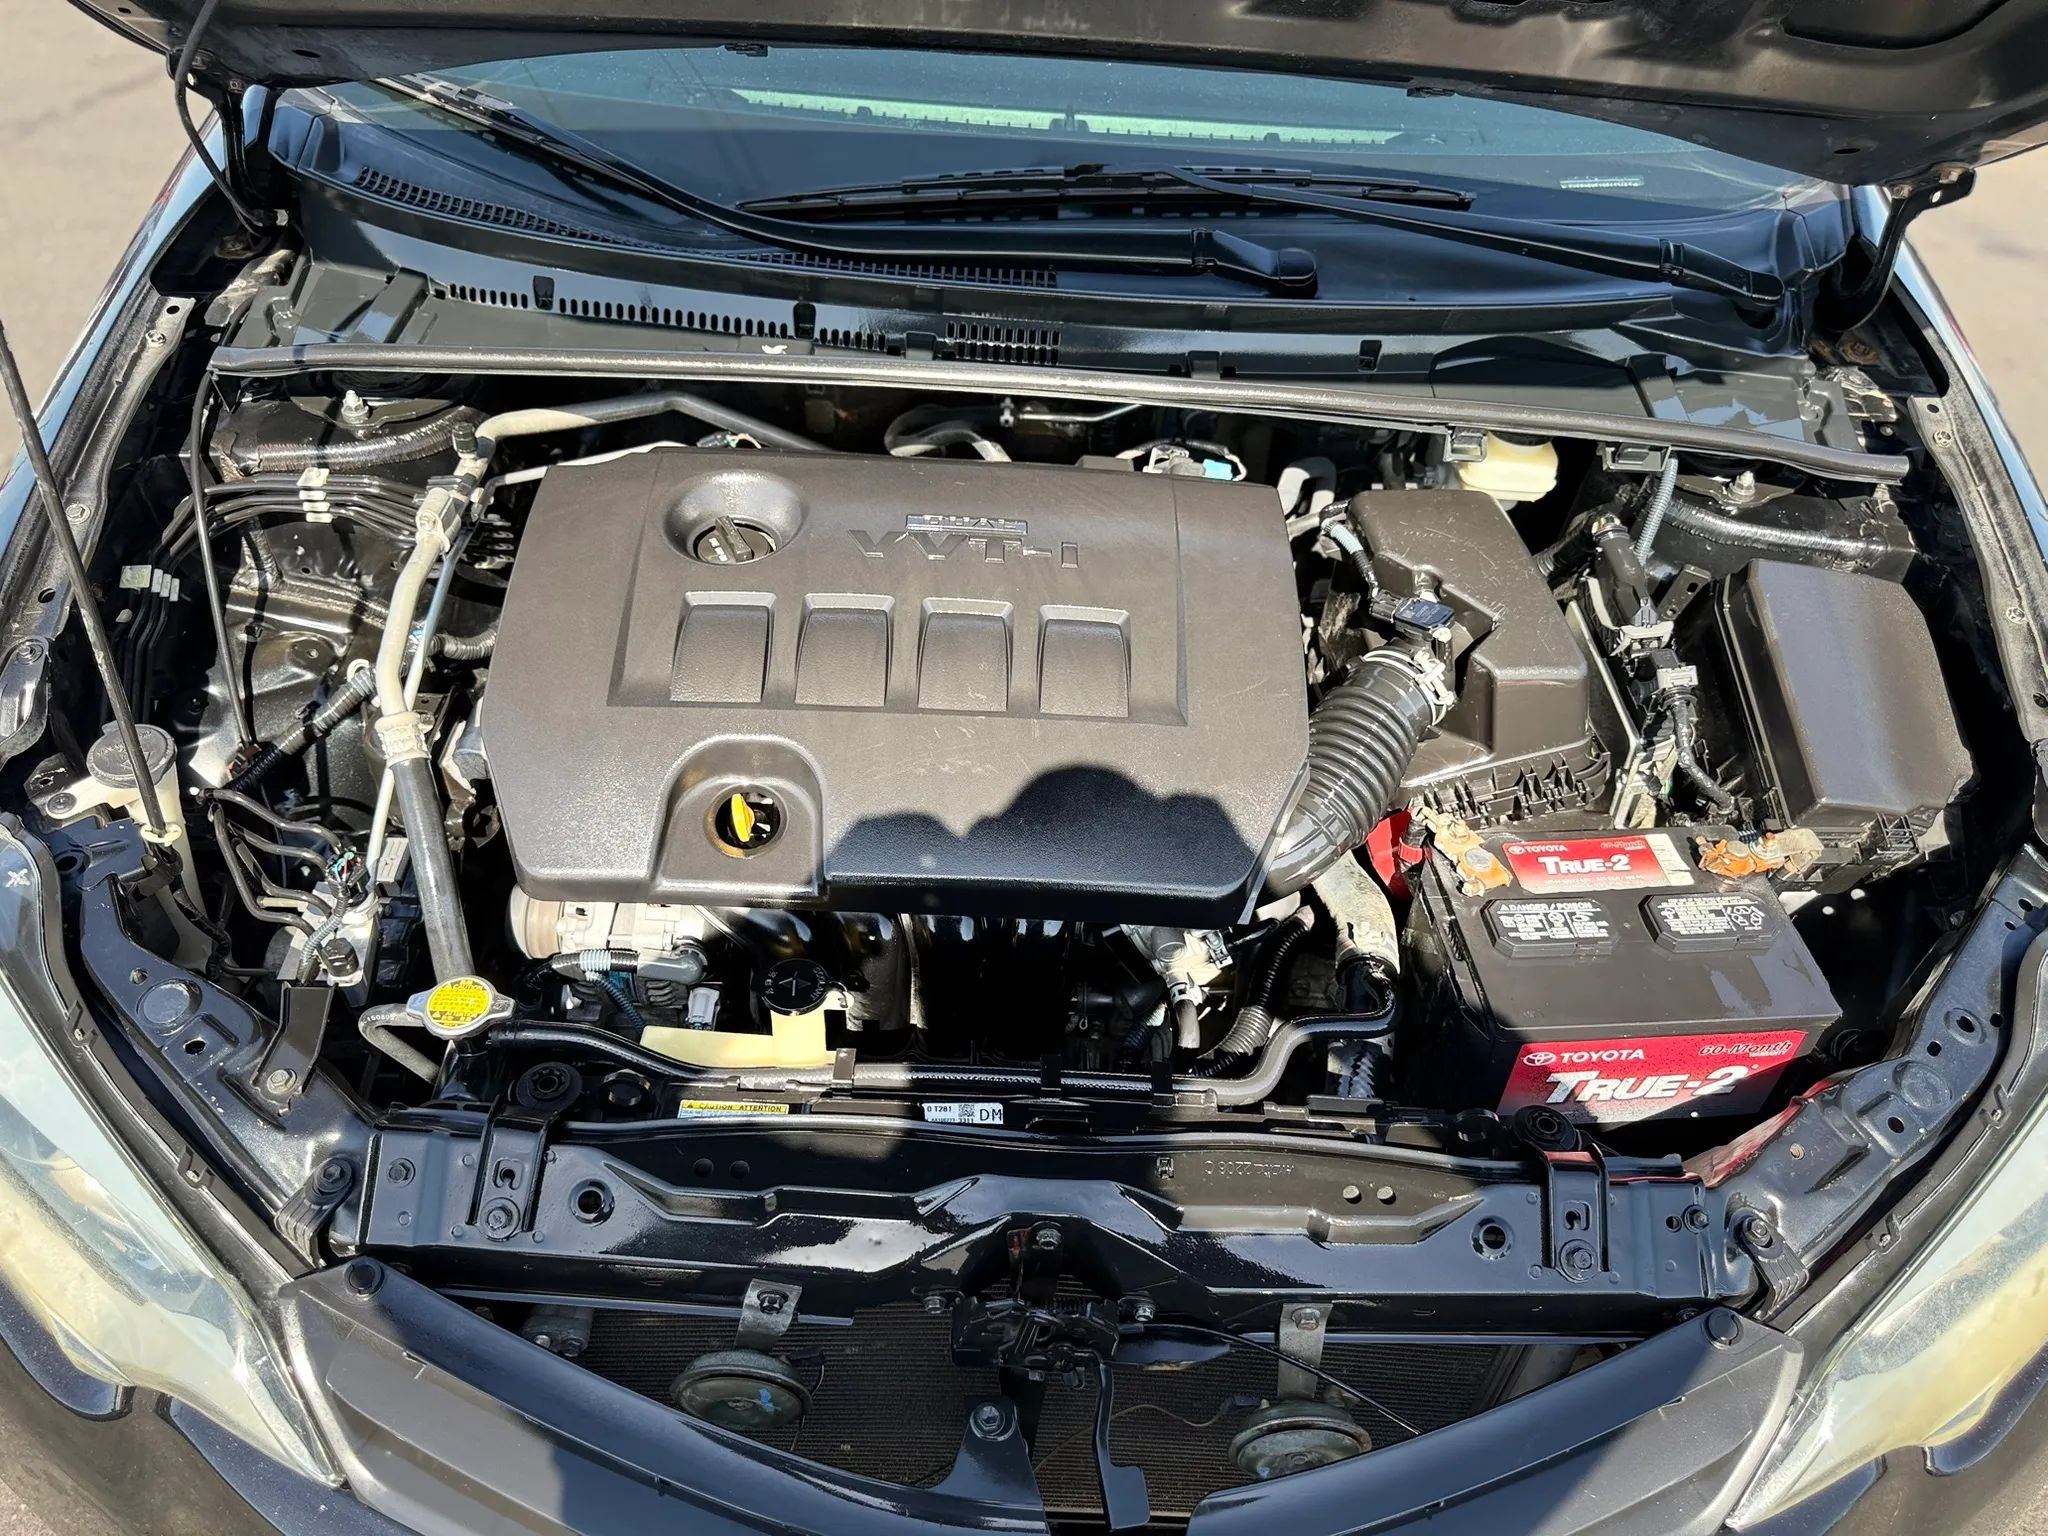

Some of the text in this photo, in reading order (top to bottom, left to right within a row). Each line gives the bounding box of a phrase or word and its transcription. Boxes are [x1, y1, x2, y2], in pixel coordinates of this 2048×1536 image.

[1526, 844, 1568, 853] TOYOTA
[1556, 902, 1593, 910] POISON
[1561, 1049, 1645, 1063] TOYOTA
[699, 1102, 782, 1112] CAUTION ATTENTION
[980, 1108, 1002, 1121] DM
